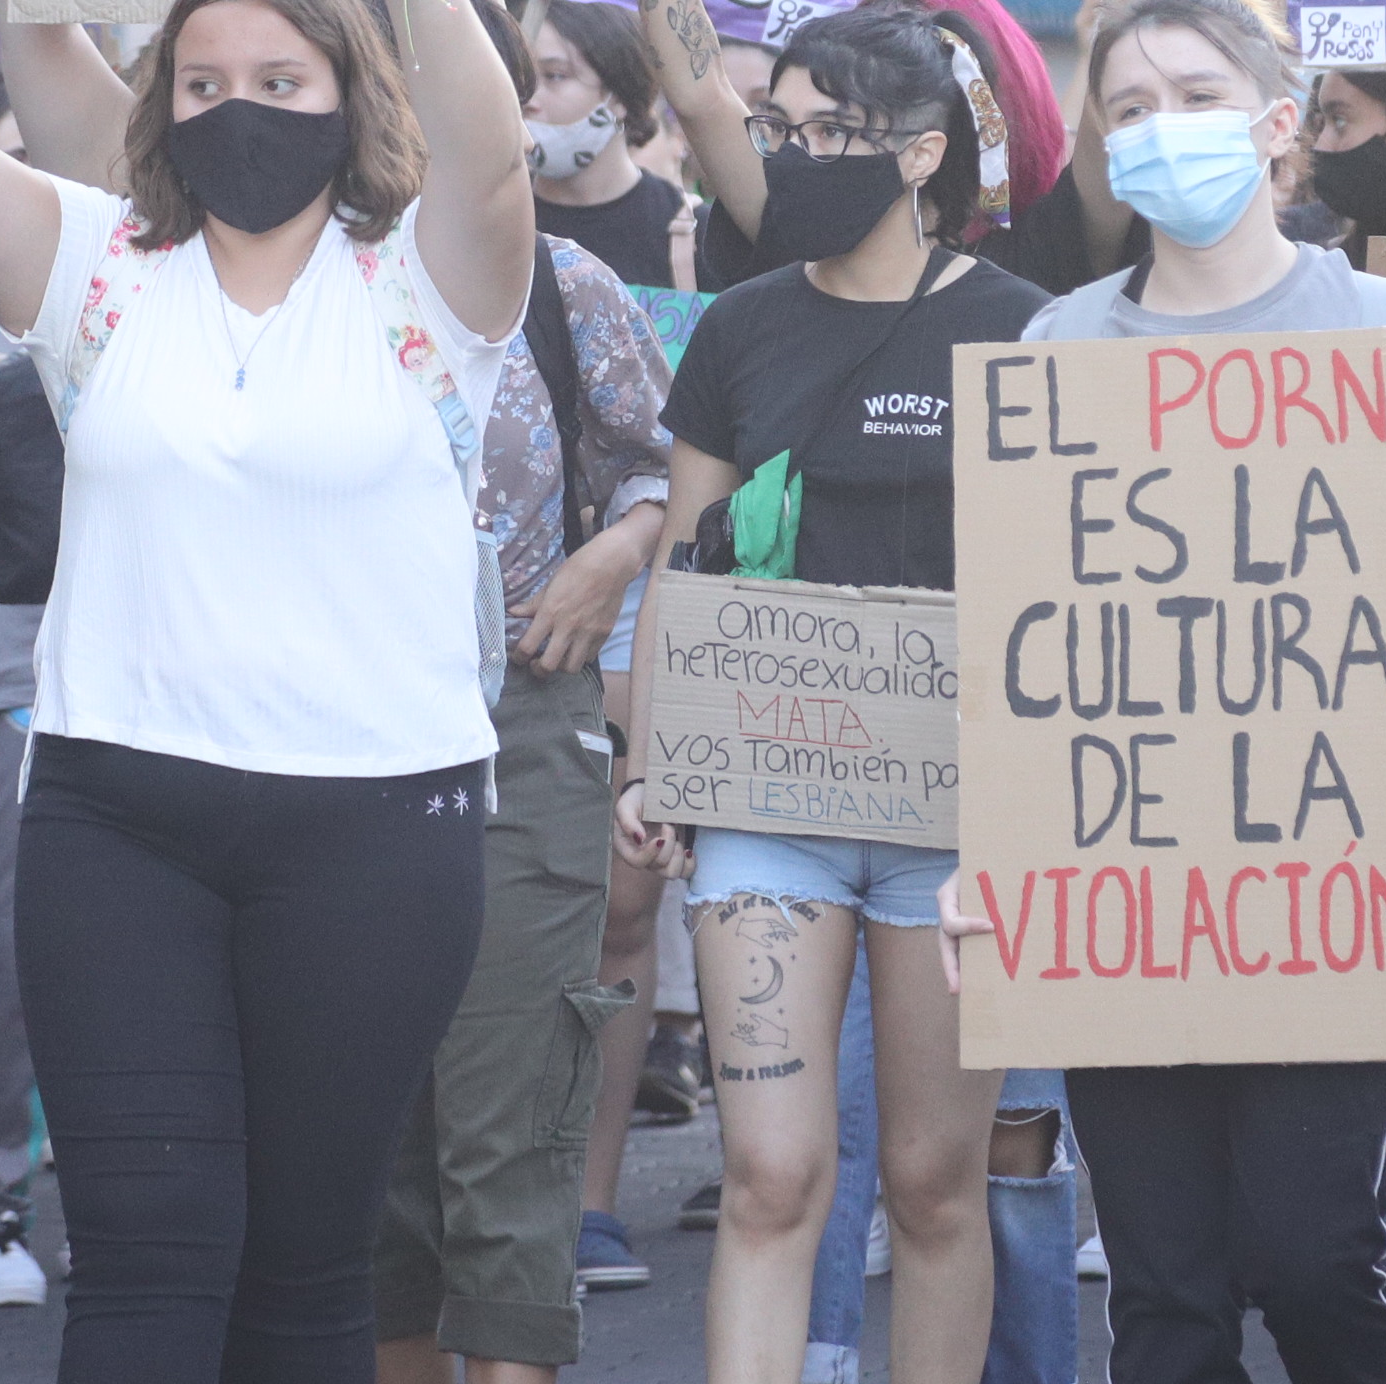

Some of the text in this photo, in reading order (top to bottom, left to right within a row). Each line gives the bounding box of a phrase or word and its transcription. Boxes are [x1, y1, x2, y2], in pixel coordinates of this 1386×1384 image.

[863, 393, 949, 422] WORST
[863, 421, 943, 437] BEHAVIOR
[985, 354, 1098, 462] EL
[1070, 464, 1361, 585] ES LA
[895, 621, 943, 669] la
[737, 690, 884, 745] MATA.
[660, 772, 732, 813] ser
[1070, 730, 1365, 848] DE LA
